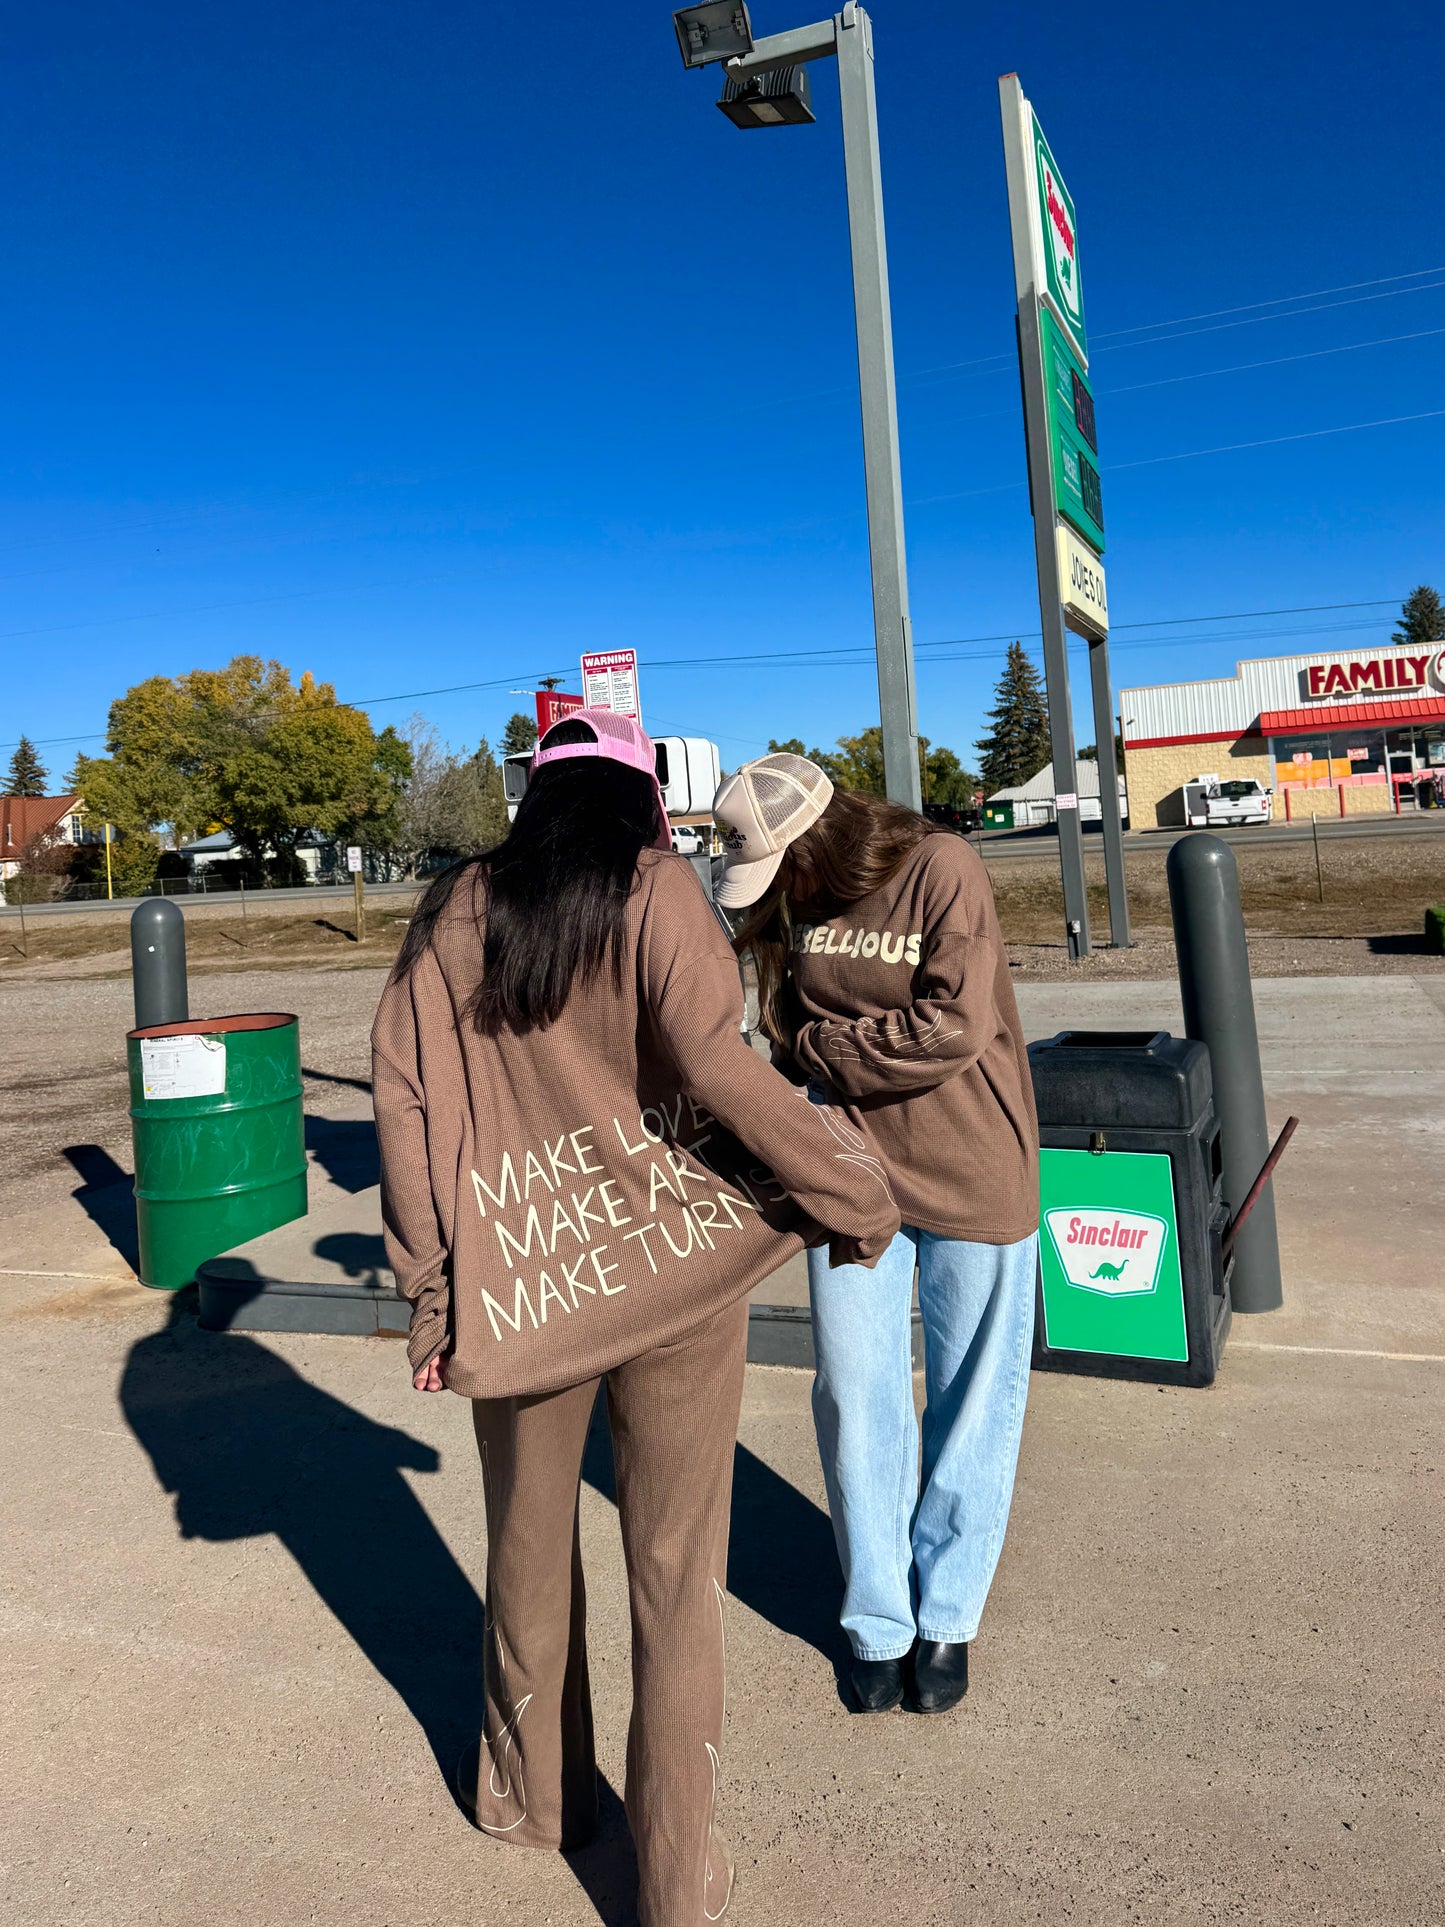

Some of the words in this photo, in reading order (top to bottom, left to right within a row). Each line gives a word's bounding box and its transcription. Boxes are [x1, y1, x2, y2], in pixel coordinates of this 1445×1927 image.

[584, 653, 633, 668] WARNING
[1309, 655, 1432, 695] FAMILY
[471, 1125, 604, 1218] MAKE
[613, 1093, 716, 1156] LOVE
[494, 1180, 632, 1268] MAKE
[649, 1134, 724, 1213] ART
[1067, 1217, 1149, 1249] Sinclair
[481, 1245, 627, 1342] MAKE
[623, 1168, 789, 1275] TURNS
